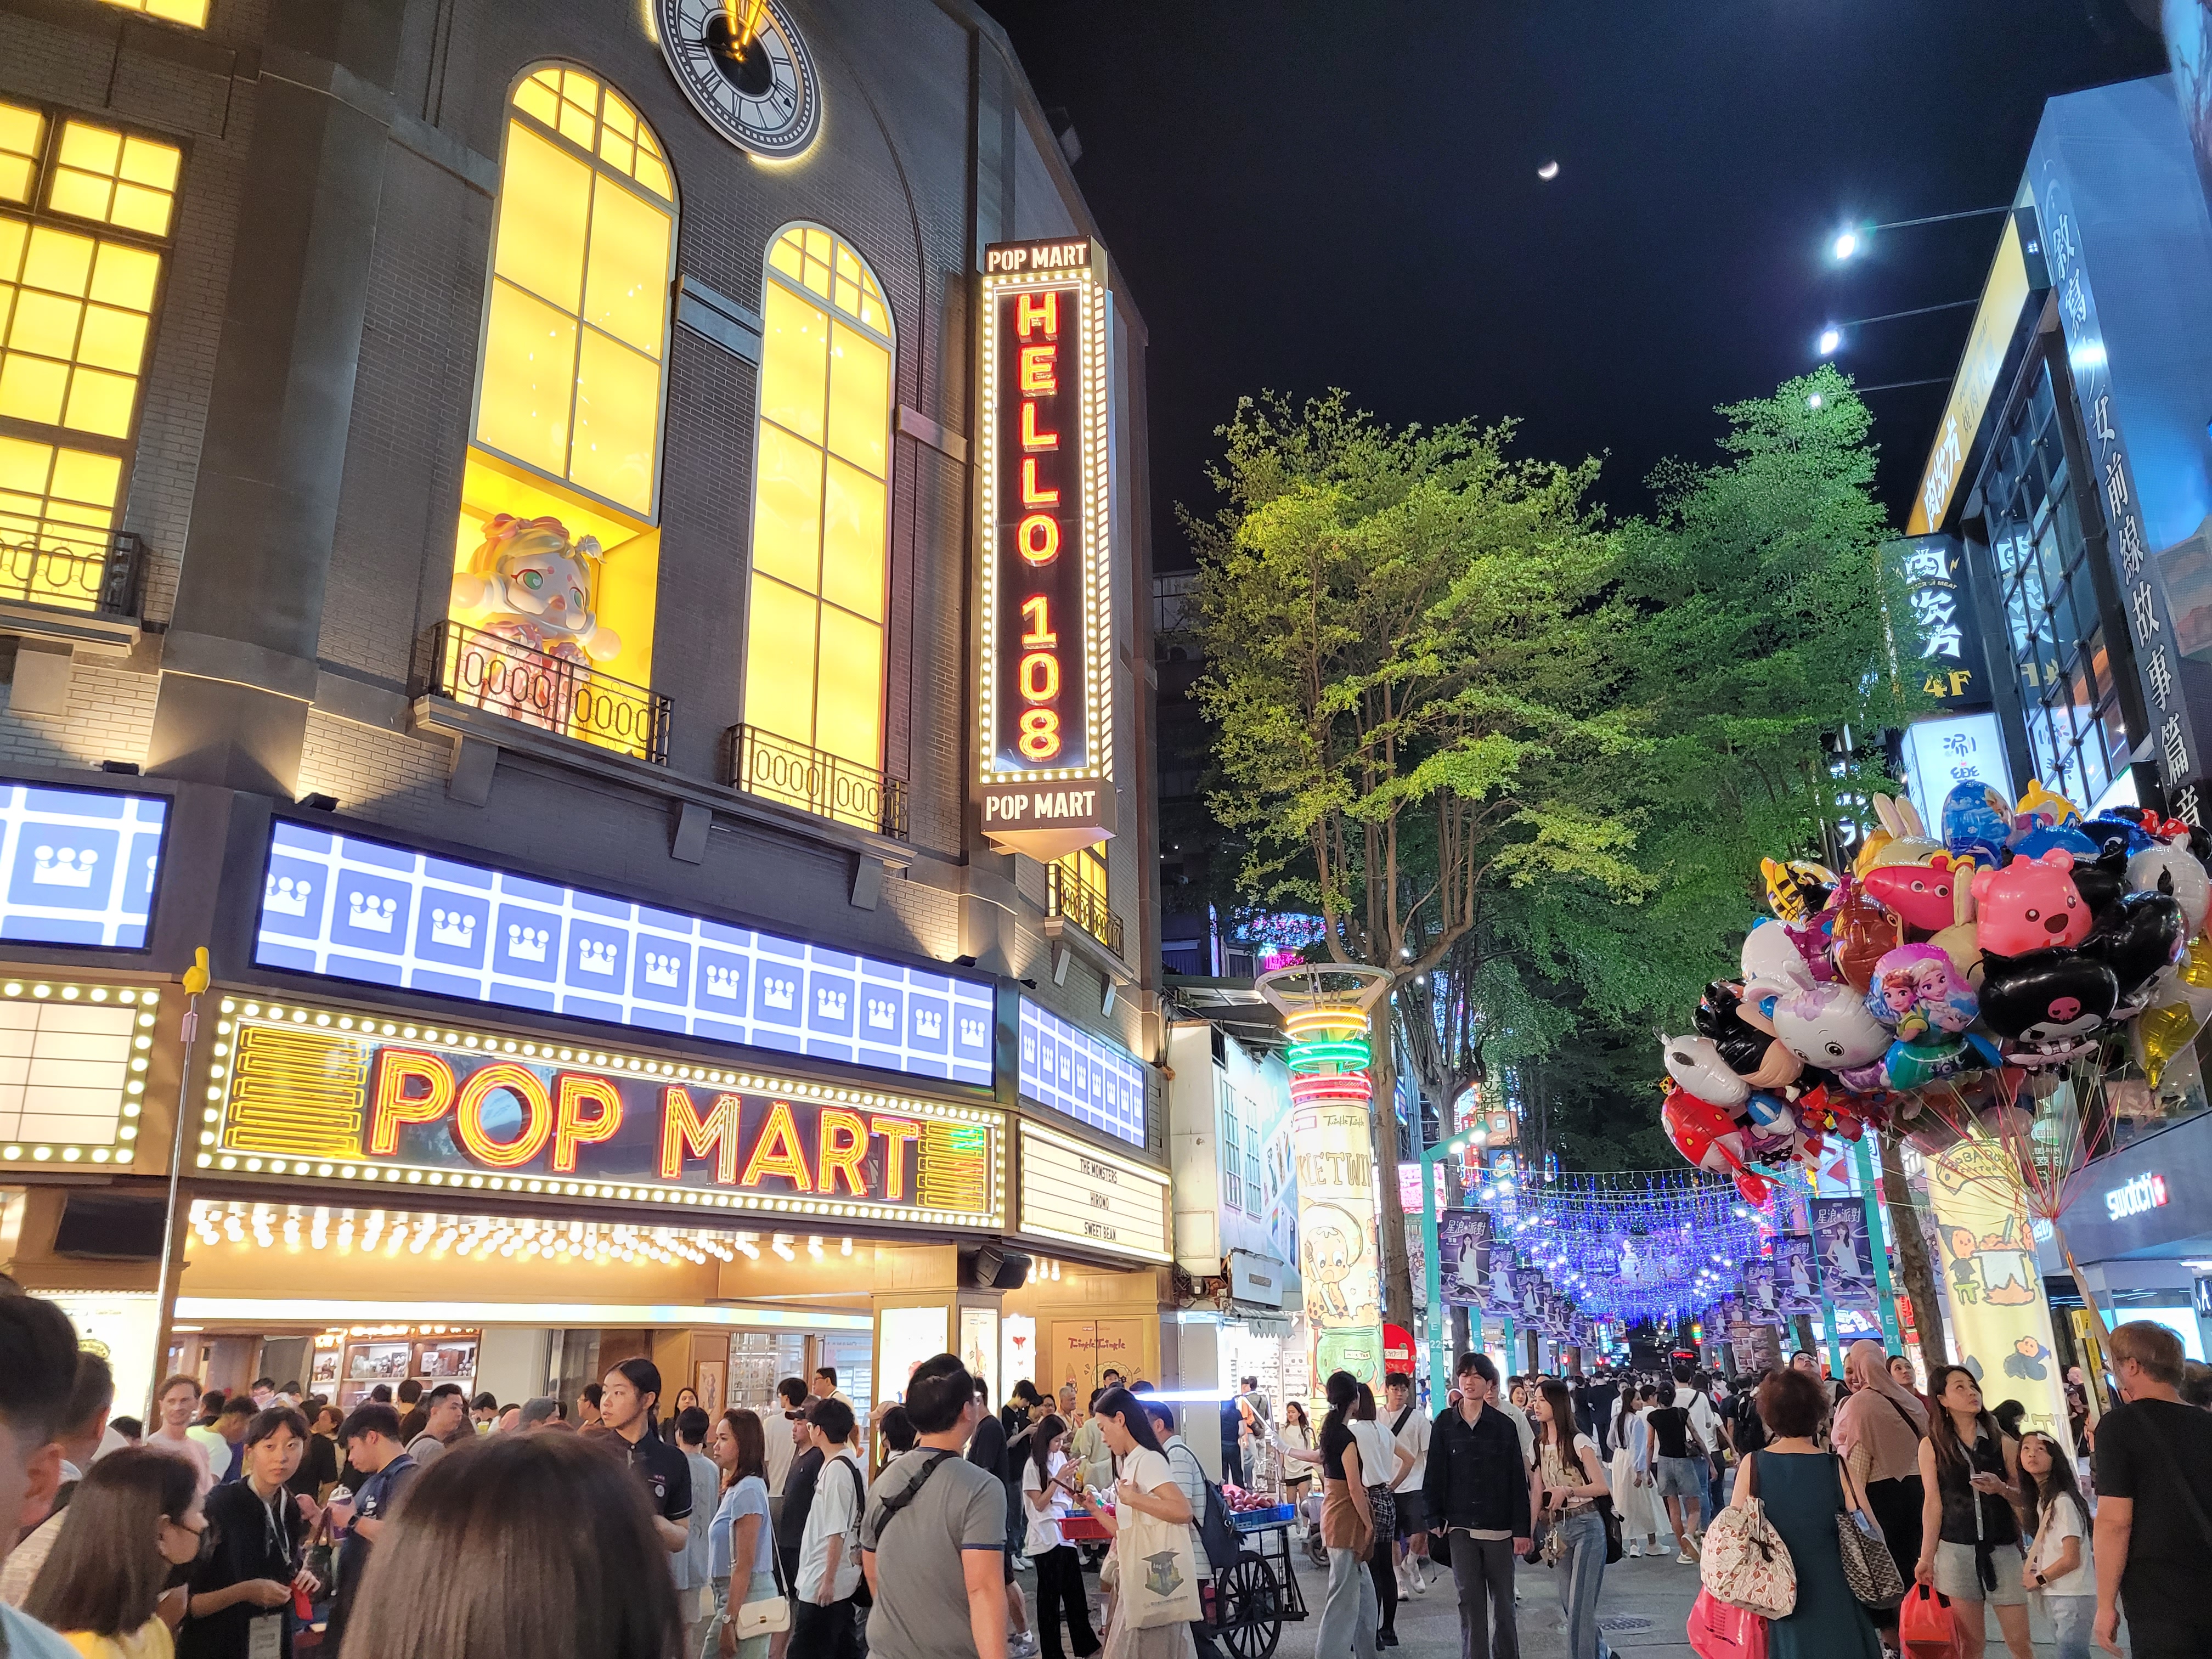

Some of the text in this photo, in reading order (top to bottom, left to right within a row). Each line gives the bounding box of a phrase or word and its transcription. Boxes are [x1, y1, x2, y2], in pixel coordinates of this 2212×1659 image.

[988, 244, 1087, 272] POP MART
[1016, 291, 1062, 759] HELLO 108
[1938, 579, 1959, 590] MEAT
[1923, 669, 1973, 698] 4F
[985, 791, 1096, 821] POP MART
[366, 1044, 921, 1201] POP MART
[1323, 1115, 1348, 1126] Twinkle
[1080, 1158, 1118, 1184] THE MONSTERS
[1090, 1193, 1109, 1210] HIRONO
[2106, 1172, 2157, 1222] swatch
[1084, 1221, 1116, 1241] SWEET BEAN
[1886, 1315, 1895, 1325] E
[1068, 1337, 1126, 1351] Twinkle Twinkle
[1430, 1340, 1441, 1348] 22
[1887, 1335, 1899, 1344] 21
